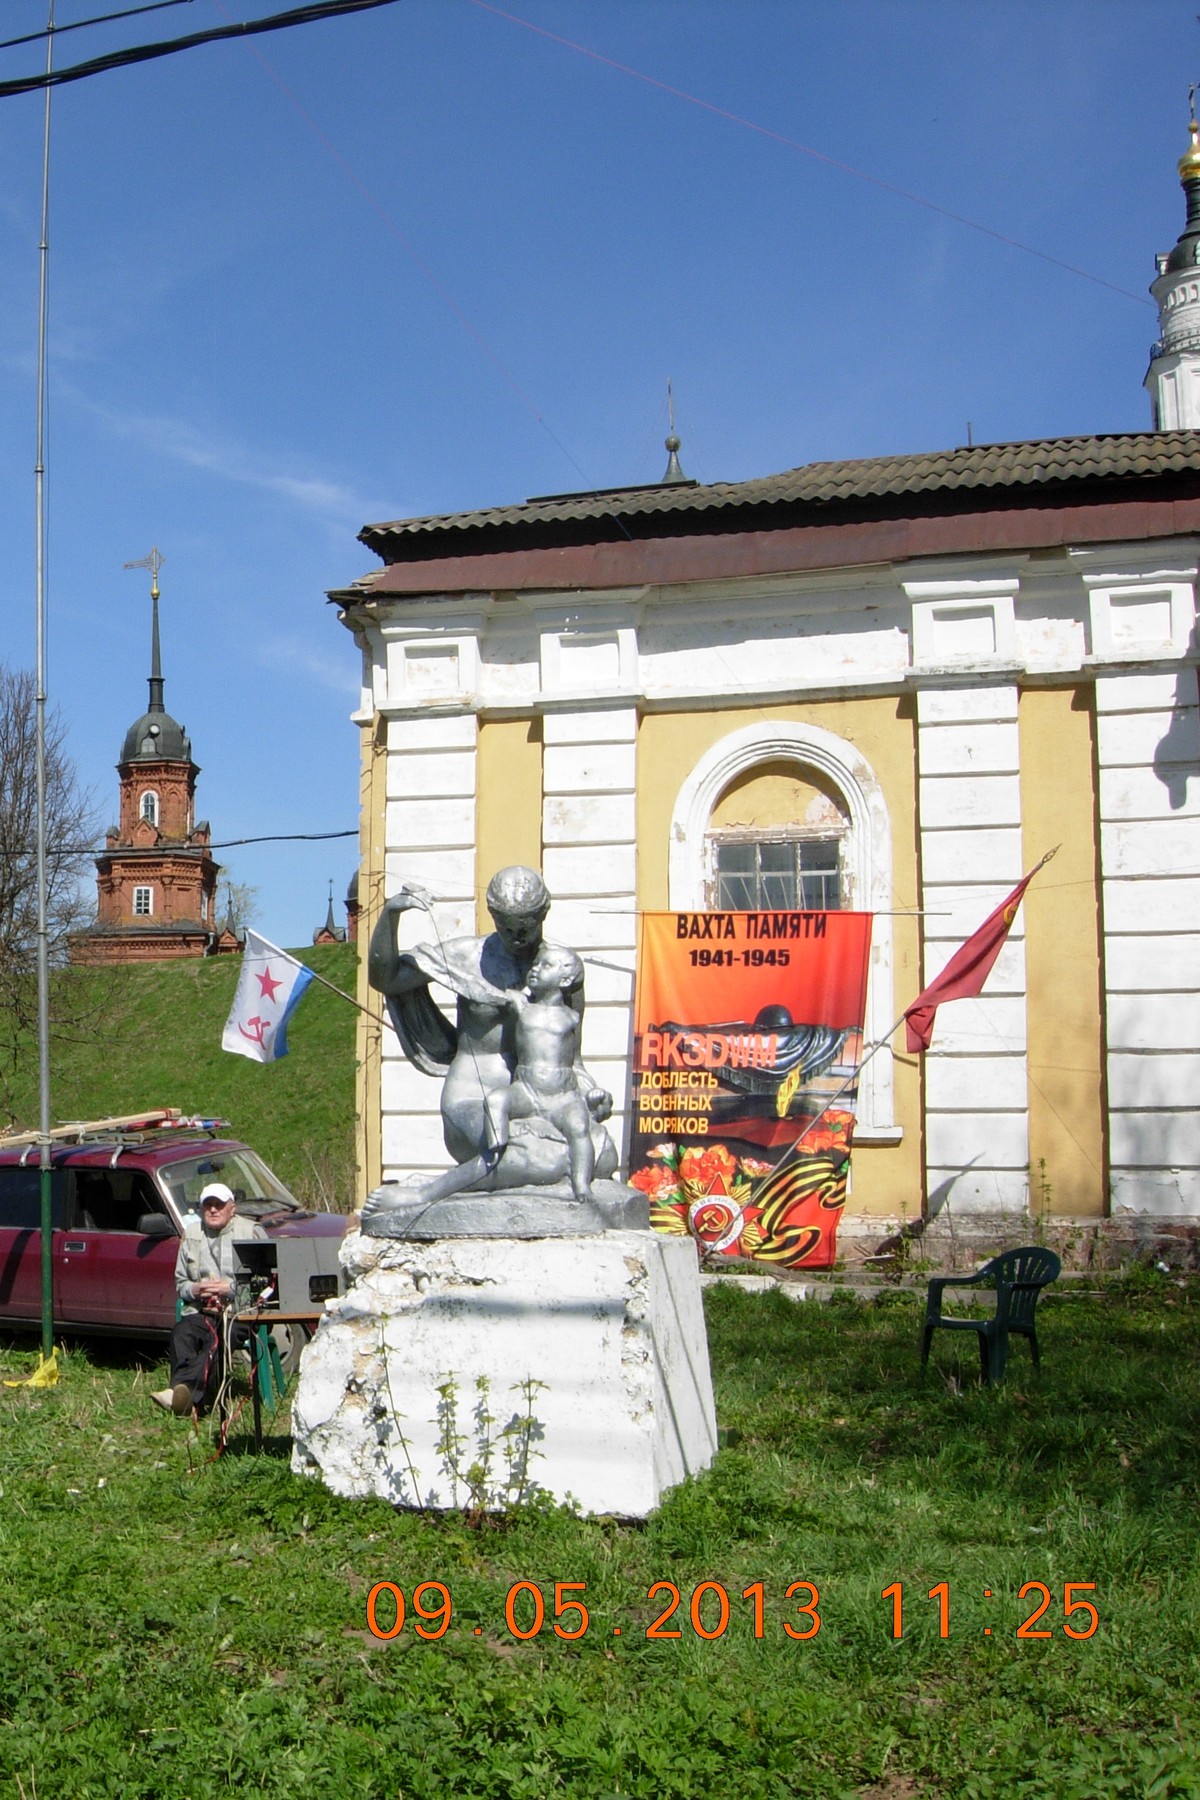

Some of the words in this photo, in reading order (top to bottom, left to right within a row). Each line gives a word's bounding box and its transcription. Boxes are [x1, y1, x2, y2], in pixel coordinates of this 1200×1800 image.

[676, 914, 736, 939] ВАХТА
[746, 914, 827, 939] ПАМЯТИ
[689, 949, 790, 967] 1941-1945
[640, 1071, 719, 1089] ДОБЛЕСТЬ
[639, 1094, 713, 1112] ВОЕННЫХ
[639, 1117, 709, 1134] МОРЯКОВ
